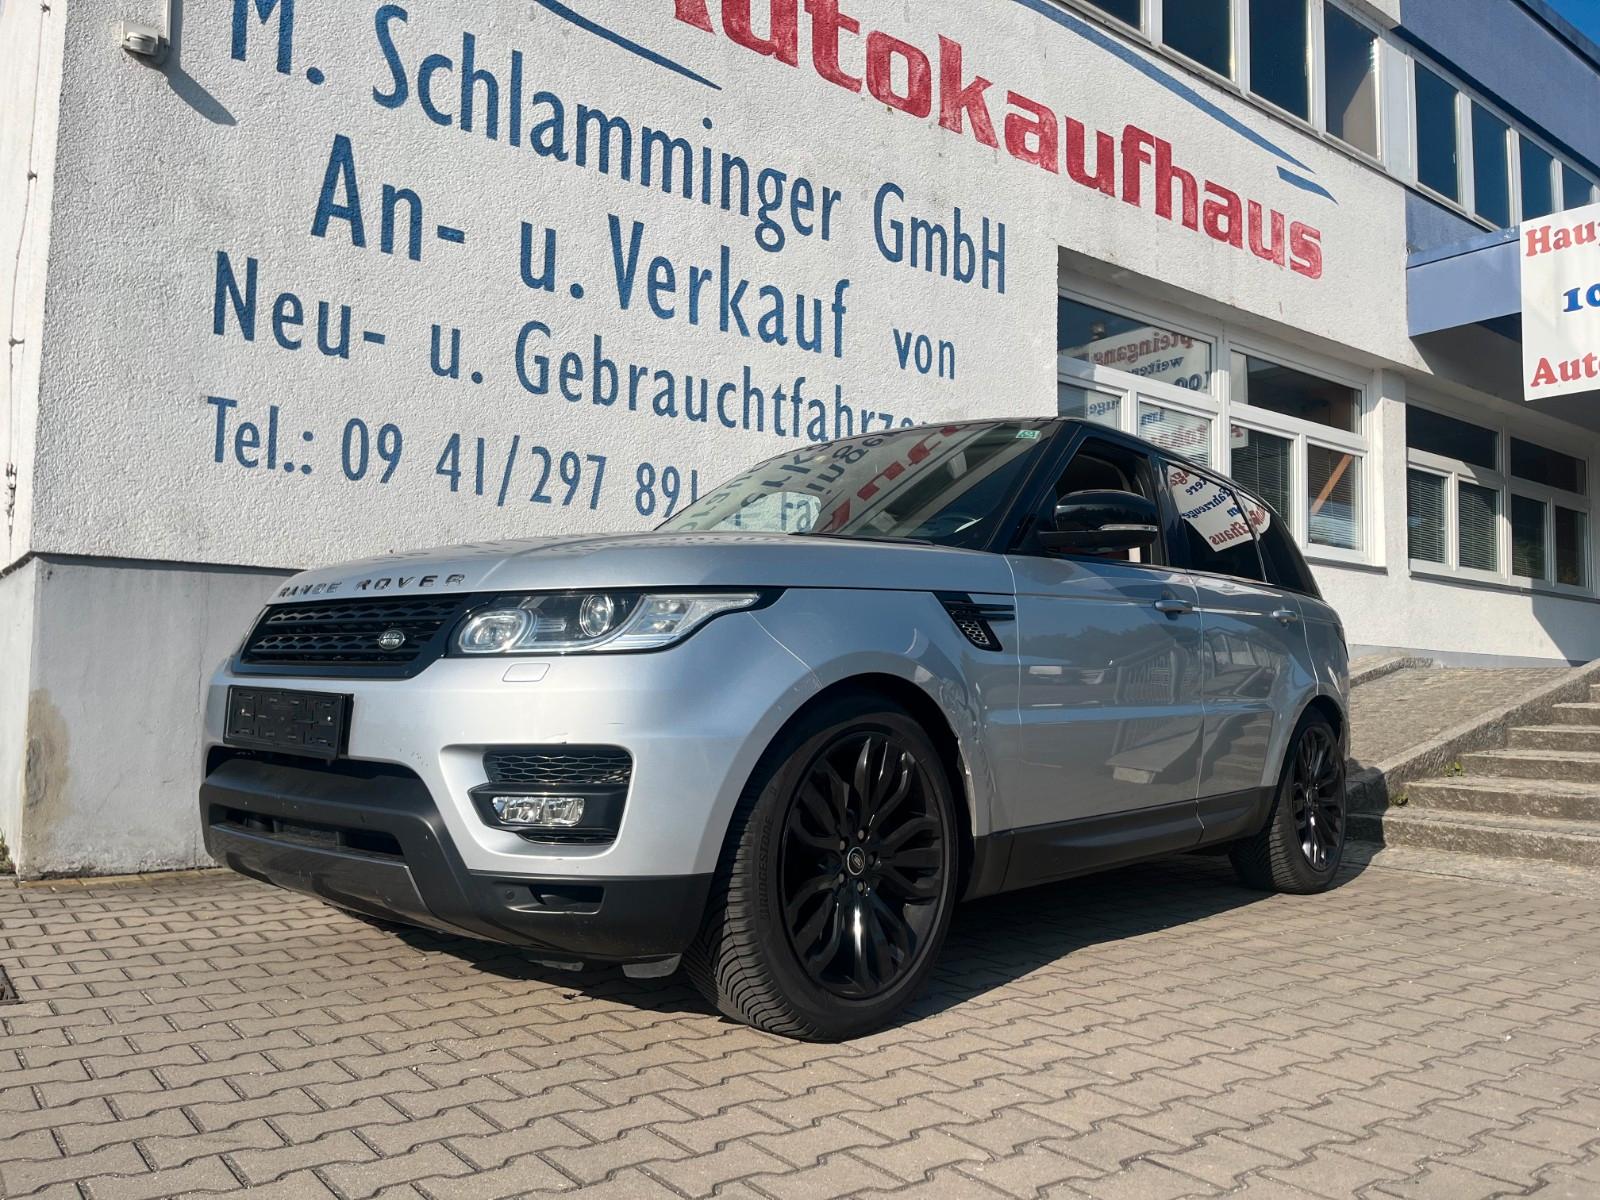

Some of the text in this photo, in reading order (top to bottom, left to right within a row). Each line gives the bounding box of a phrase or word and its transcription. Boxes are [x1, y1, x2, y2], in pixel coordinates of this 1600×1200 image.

[231, 0, 1006, 294] M. Schlamminger GmbH
[674, 0, 1323, 280] utokaufhaus
[311, 134, 956, 379] An- u. Verkauf von
[1525, 221, 1600, 257] Hau
[213, 250, 386, 360] Neu-
[431, 323, 483, 385] u.
[1530, 352, 1600, 387] Aut
[207, 396, 315, 474] Tel.:
[342, 418, 402, 483] 09
[354, 573, 466, 591] ROVER
